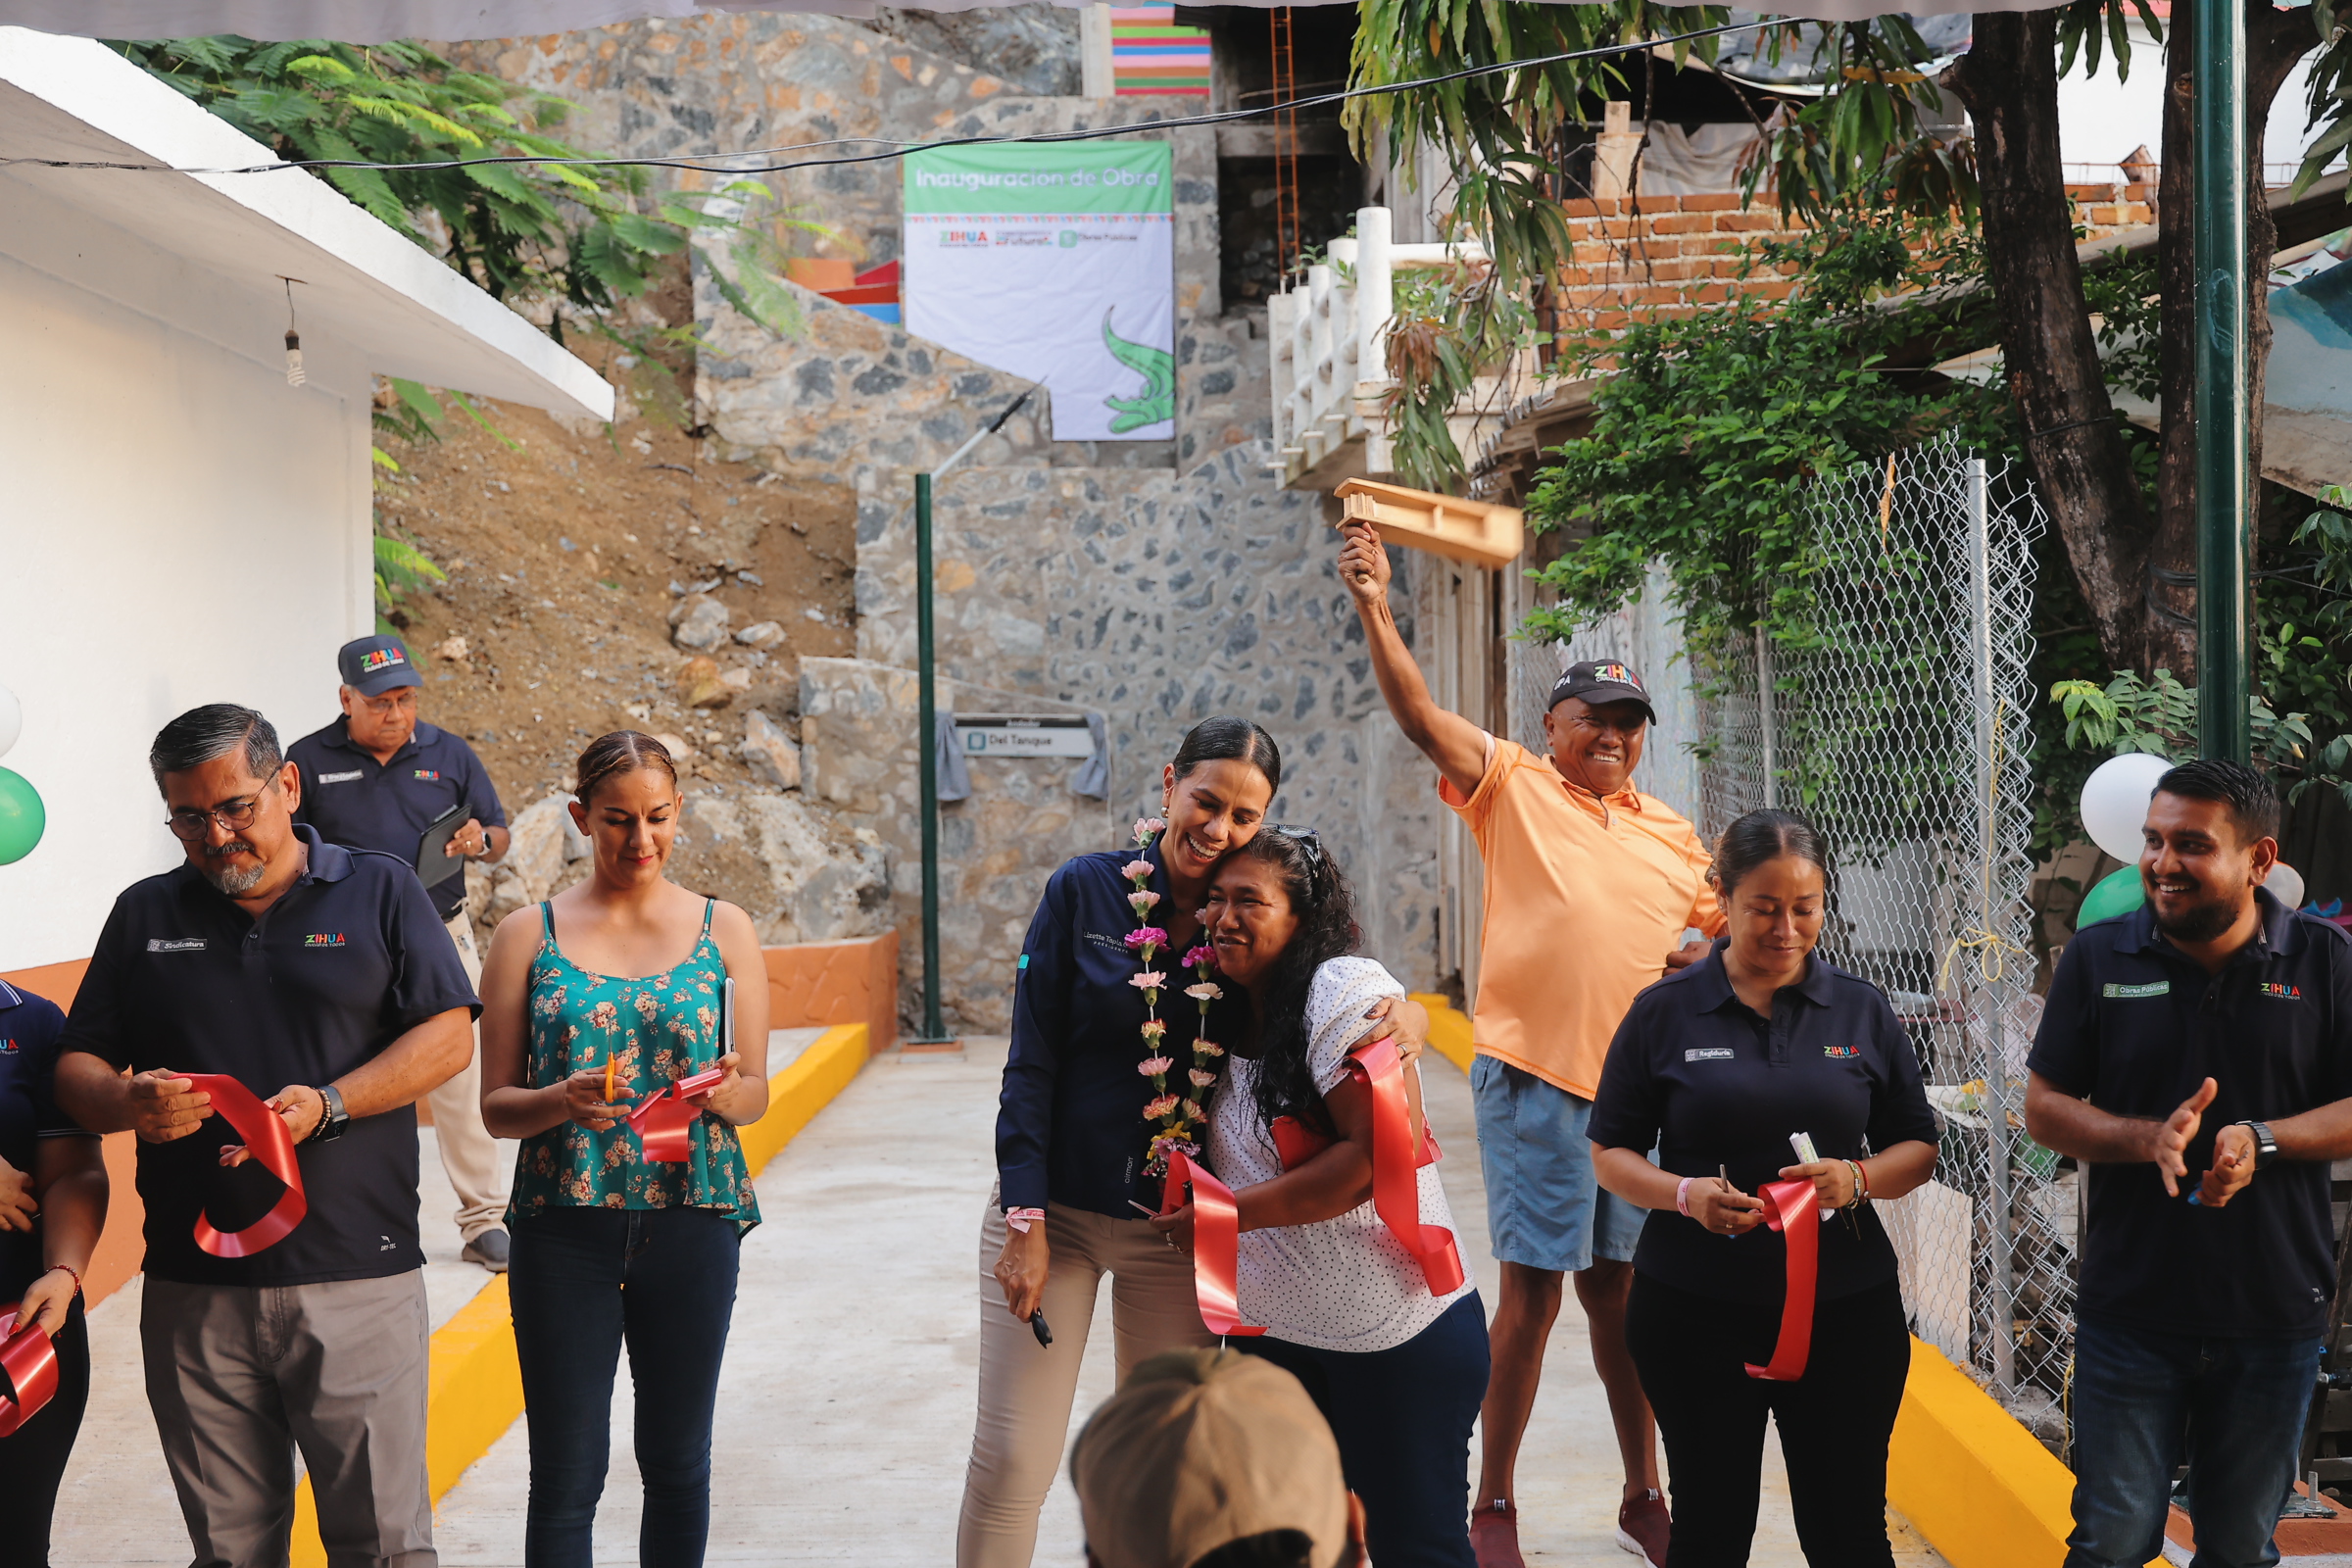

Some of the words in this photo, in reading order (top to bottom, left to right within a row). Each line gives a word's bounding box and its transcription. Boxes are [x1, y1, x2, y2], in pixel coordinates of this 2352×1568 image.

[915, 169, 1063, 192] Inauguración
[1069, 169, 1097, 186] de
[1102, 167, 1160, 186] Obra
[940, 230, 988, 243] ZIHUA
[361, 647, 404, 667] ZIHUA
[1594, 664, 1642, 687] ZIHUA
[990, 734, 1007, 745] Del
[1010, 734, 1052, 749] Tanque
[305, 933, 346, 944] ZIHUA
[1083, 931, 1105, 941] Lizette
[164, 941, 205, 950] Sindicatura
[2141, 983, 2168, 994] Públicas
[2261, 983, 2301, 997] ZIHUA
[1824, 1046, 1860, 1055] ZIHUA
